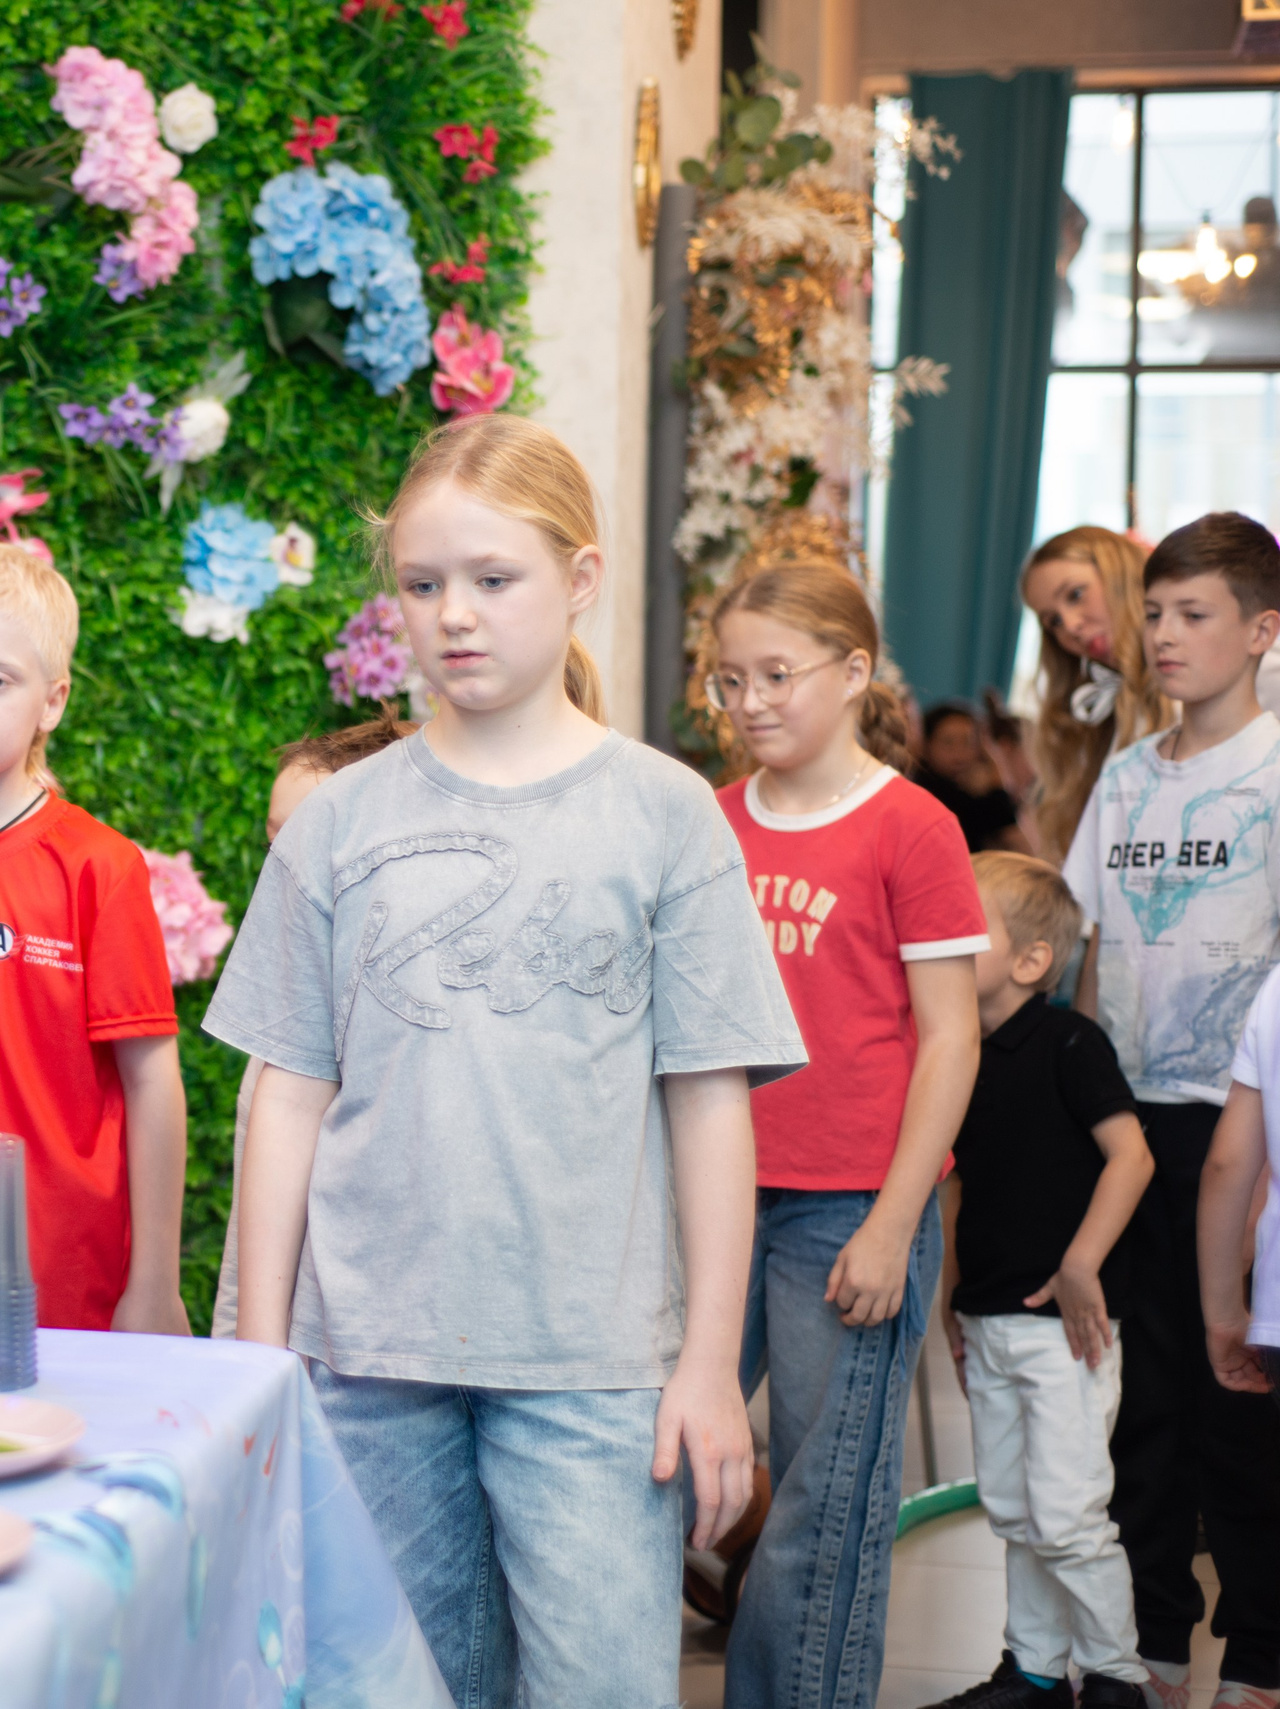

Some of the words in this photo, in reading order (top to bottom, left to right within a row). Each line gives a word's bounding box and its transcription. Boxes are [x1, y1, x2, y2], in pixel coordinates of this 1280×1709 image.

[1106, 841, 1166, 869] DEEP
[1177, 840, 1230, 867] SEA
[26, 935, 74, 951] АКАДЕМИЯ
[25, 945, 60, 958] ХОККЕЯ
